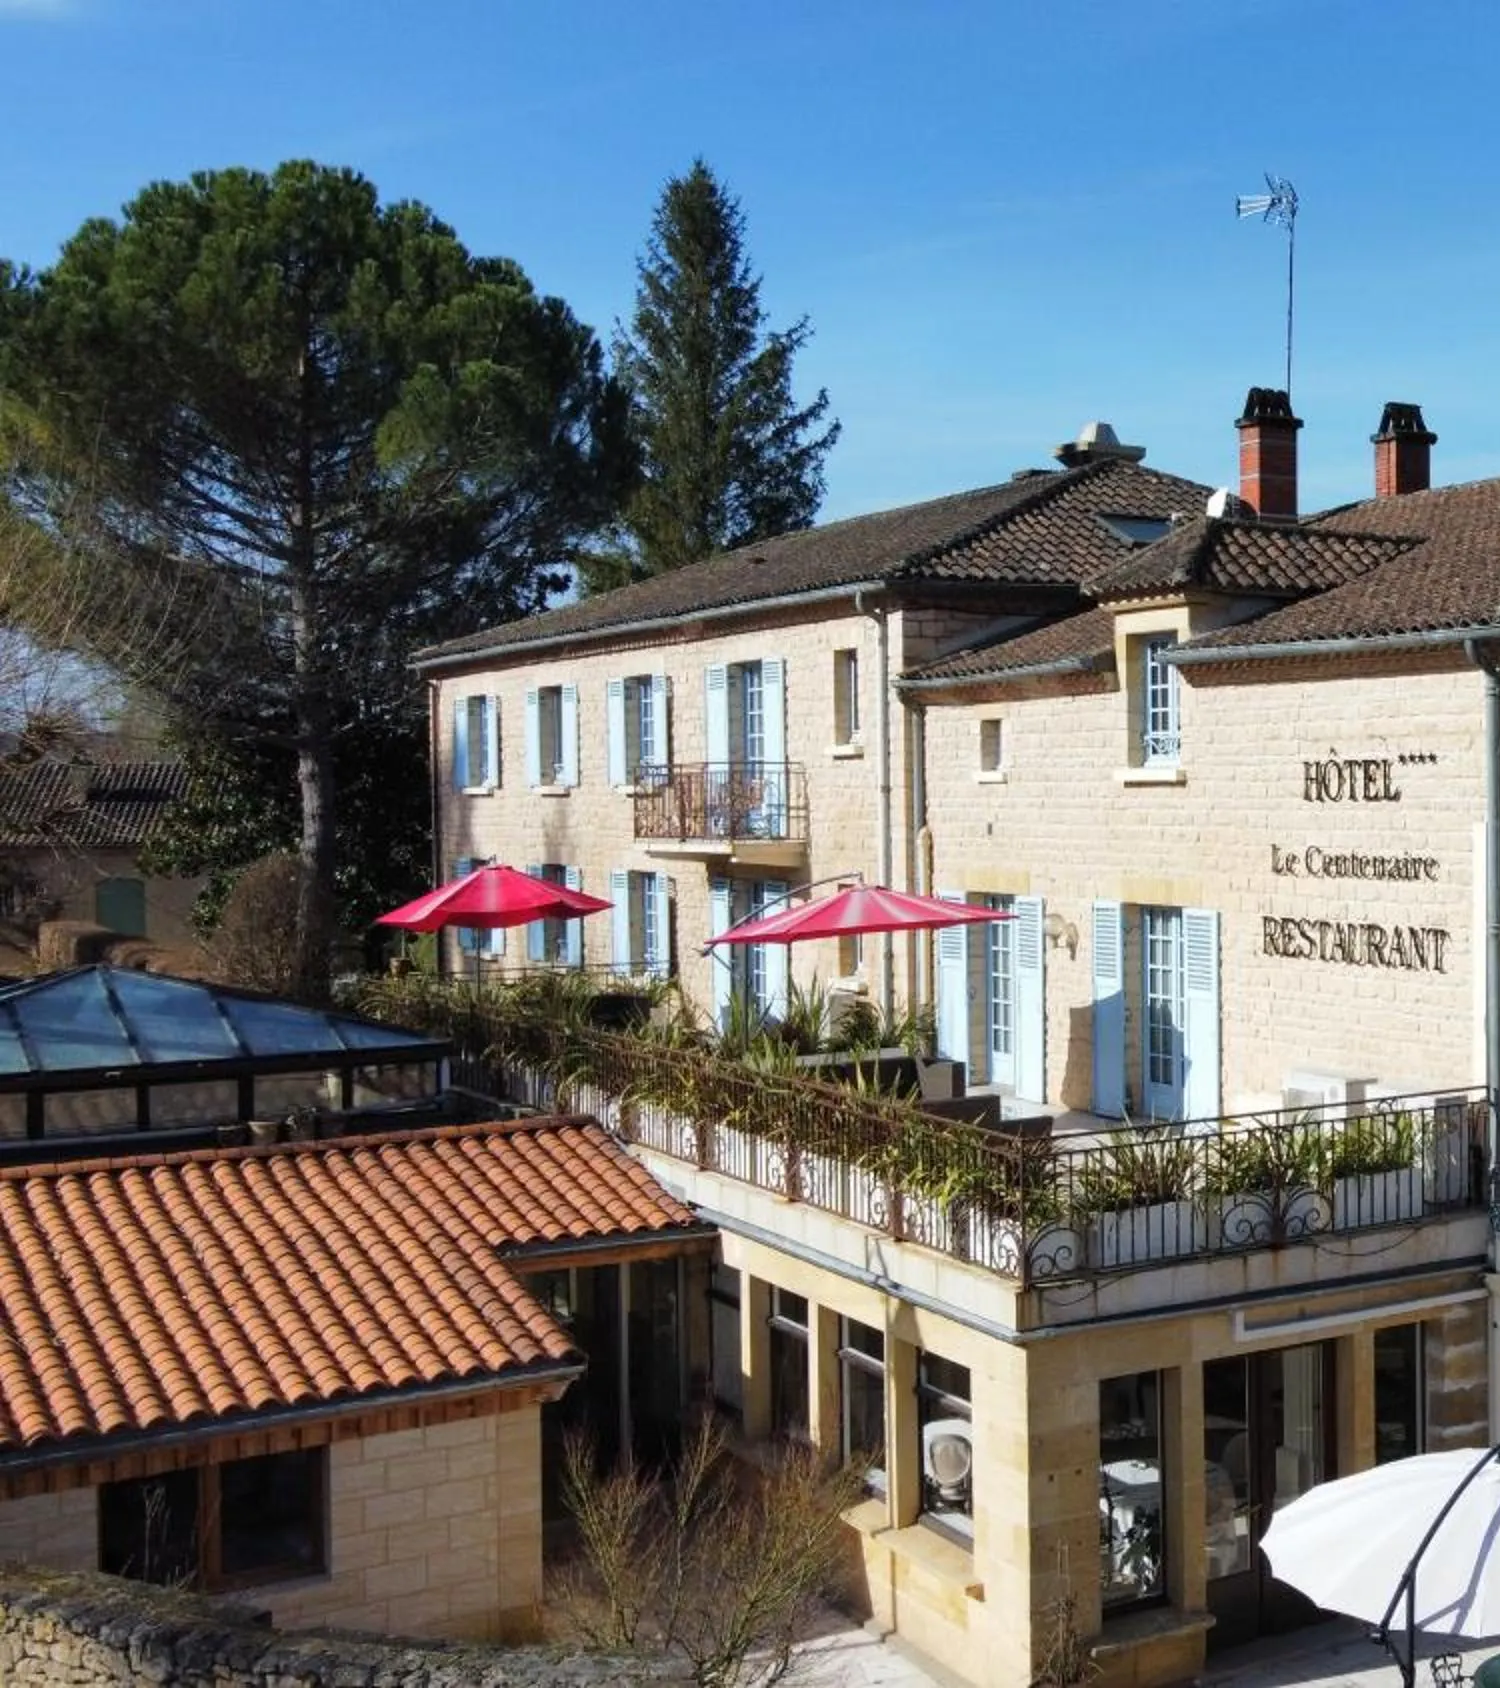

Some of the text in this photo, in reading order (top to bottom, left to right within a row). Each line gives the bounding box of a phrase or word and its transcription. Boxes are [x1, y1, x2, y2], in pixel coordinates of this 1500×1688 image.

[1303, 747, 1401, 802] HÔTEL
[1270, 843, 1440, 882] Le Centenaire
[1262, 916, 1451, 973] RESTAURANT
